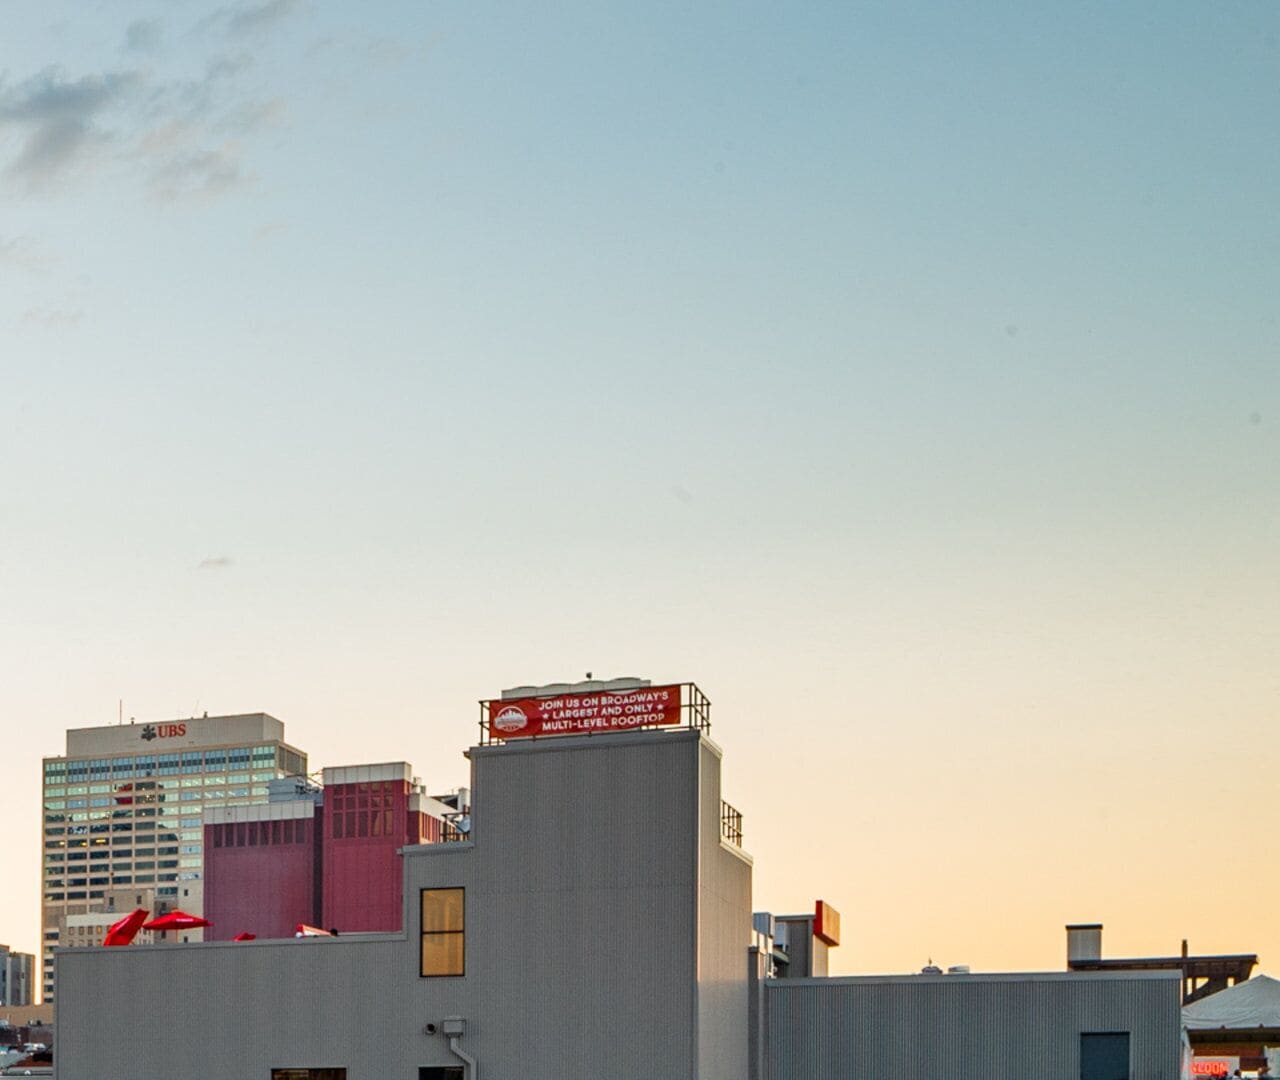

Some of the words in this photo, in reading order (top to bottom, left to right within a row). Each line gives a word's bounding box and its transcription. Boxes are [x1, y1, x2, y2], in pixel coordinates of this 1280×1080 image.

[538, 701, 563, 711] JOIN
[566, 699, 580, 708] US
[582, 697, 598, 707] ON
[601, 691, 669, 705] BROADWAY'S
[552, 708, 599, 720] LARGEST
[601, 706, 622, 716] AND
[625, 704, 653, 714] ONLY
[157, 723, 187, 738] UBS
[542, 717, 609, 731] MULTI-LEVEL
[611, 713, 665, 726] ROOFTOP
